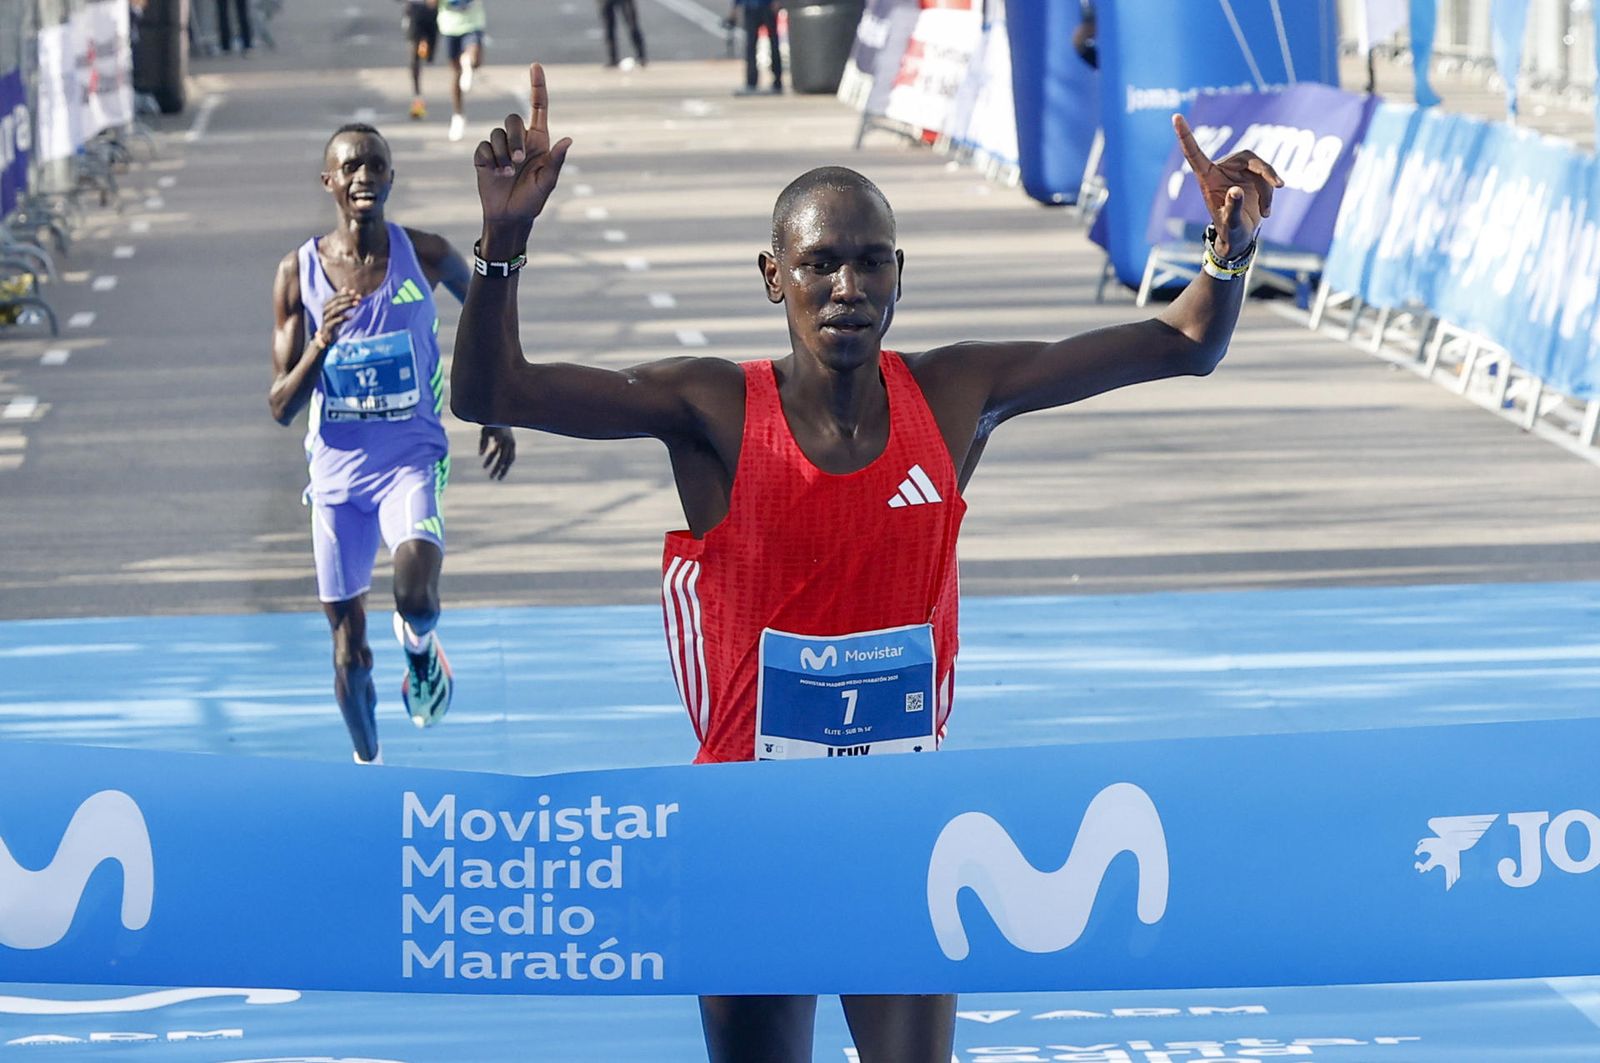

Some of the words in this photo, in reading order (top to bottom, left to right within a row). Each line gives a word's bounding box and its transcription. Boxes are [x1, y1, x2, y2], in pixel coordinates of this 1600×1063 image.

[355, 367, 378, 387] 12
[845, 645, 904, 662] Movistar
[841, 689, 858, 726] 7
[402, 791, 679, 842] Movistar
[402, 845, 623, 889] Madrid
[402, 893, 595, 935] Medio
[402, 937, 664, 981] Maratón
[843, 1036, 1421, 1055] ovistar
